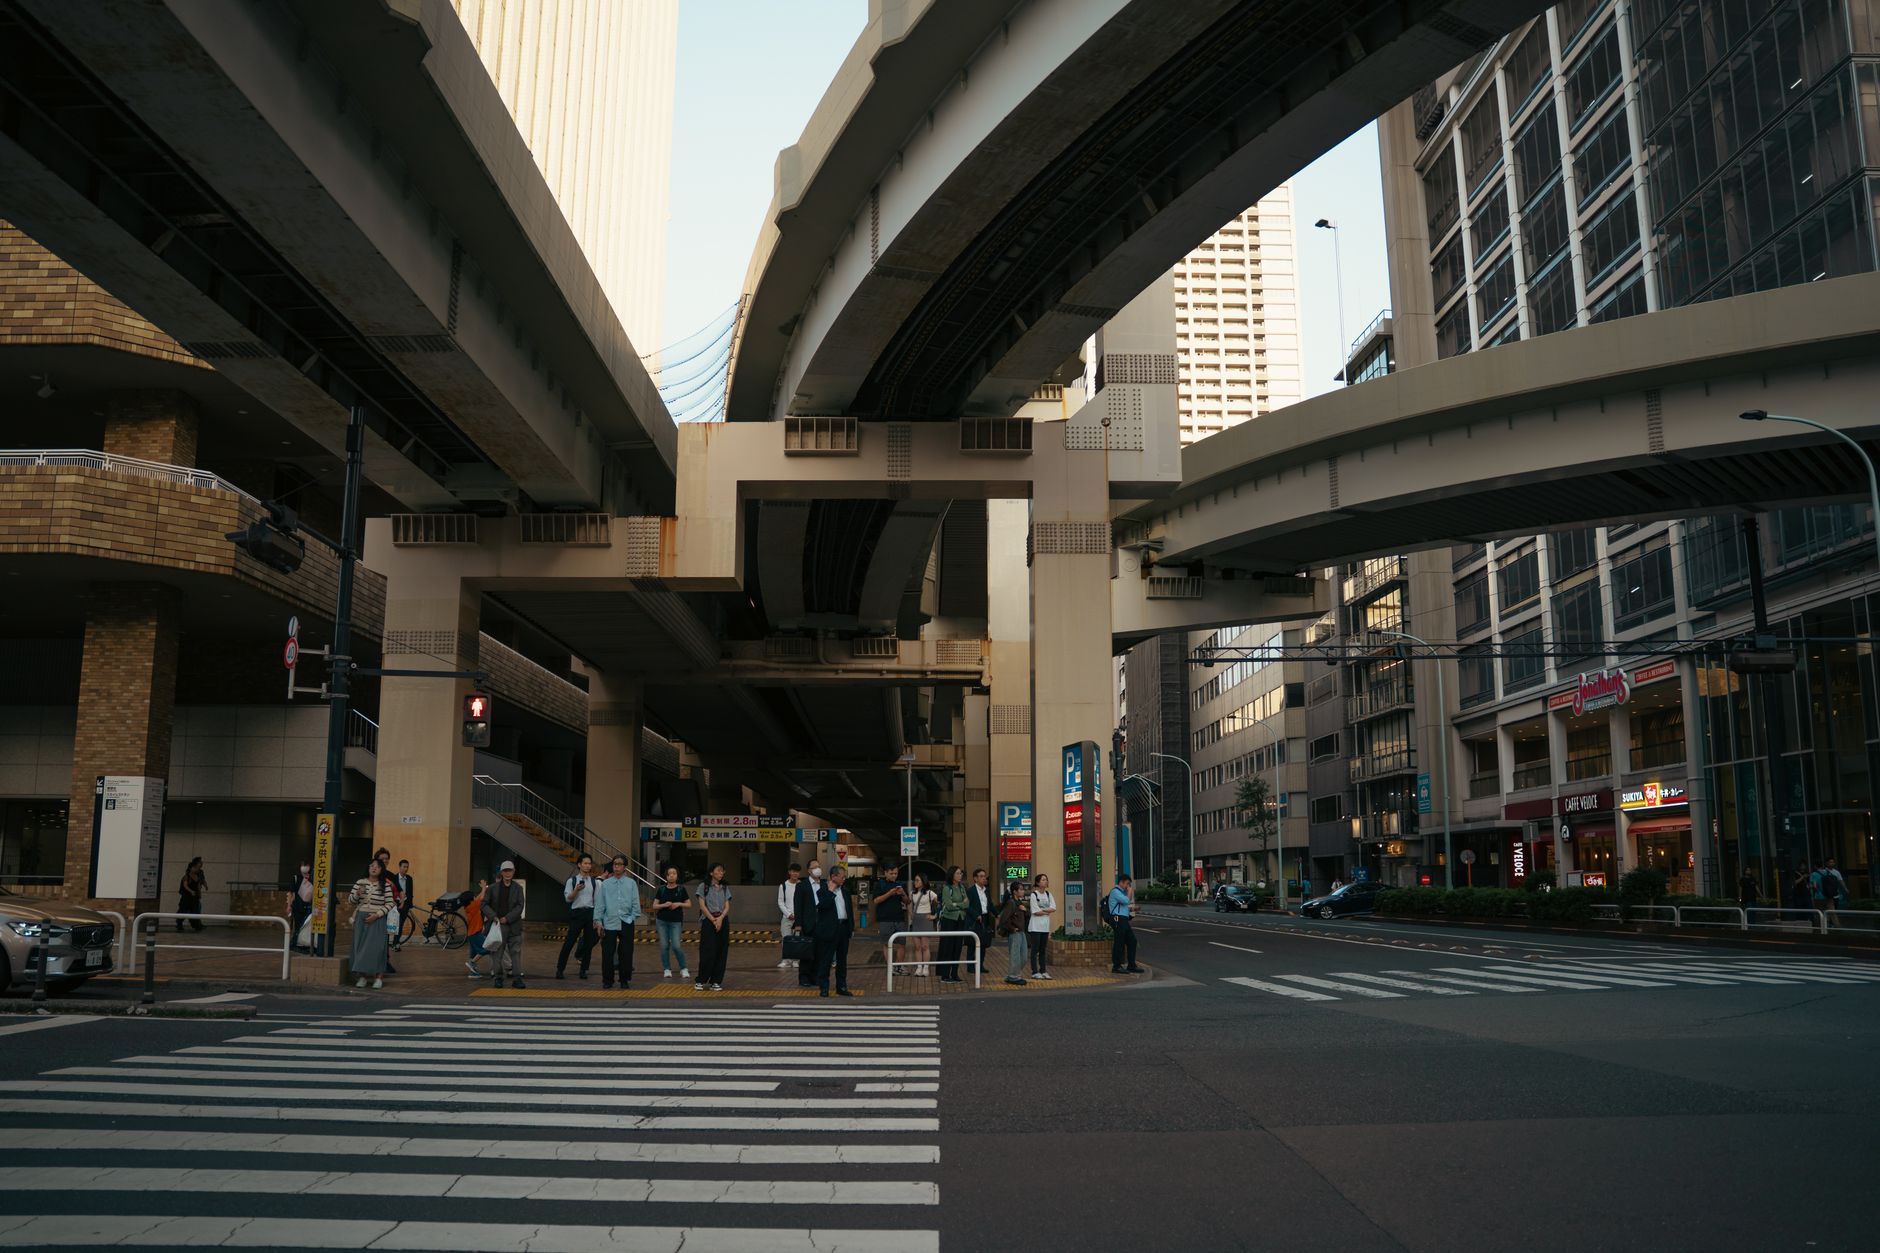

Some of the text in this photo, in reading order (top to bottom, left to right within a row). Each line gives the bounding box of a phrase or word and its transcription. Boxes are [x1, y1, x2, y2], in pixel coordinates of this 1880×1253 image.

[1573, 670, 1627, 717] Jonathan's
[1066, 751, 1075, 785] P
[1580, 794, 1598, 810] VELOCE
[1622, 792, 1643, 803] SUKIYA
[685, 817, 697, 825] B1
[733, 816, 757, 825] 2.8m
[1005, 806, 1021, 826] P
[650, 829, 659, 840] P
[685, 830, 698, 839] B2
[733, 830, 757, 839] 2.1m
[819, 830, 829, 841] P
[1068, 852, 1080, 873] 空車
[1514, 848, 1525, 877] VELOCE
[315, 838, 328, 920] 子供とびだし
[1007, 866, 1029, 879] 空車
